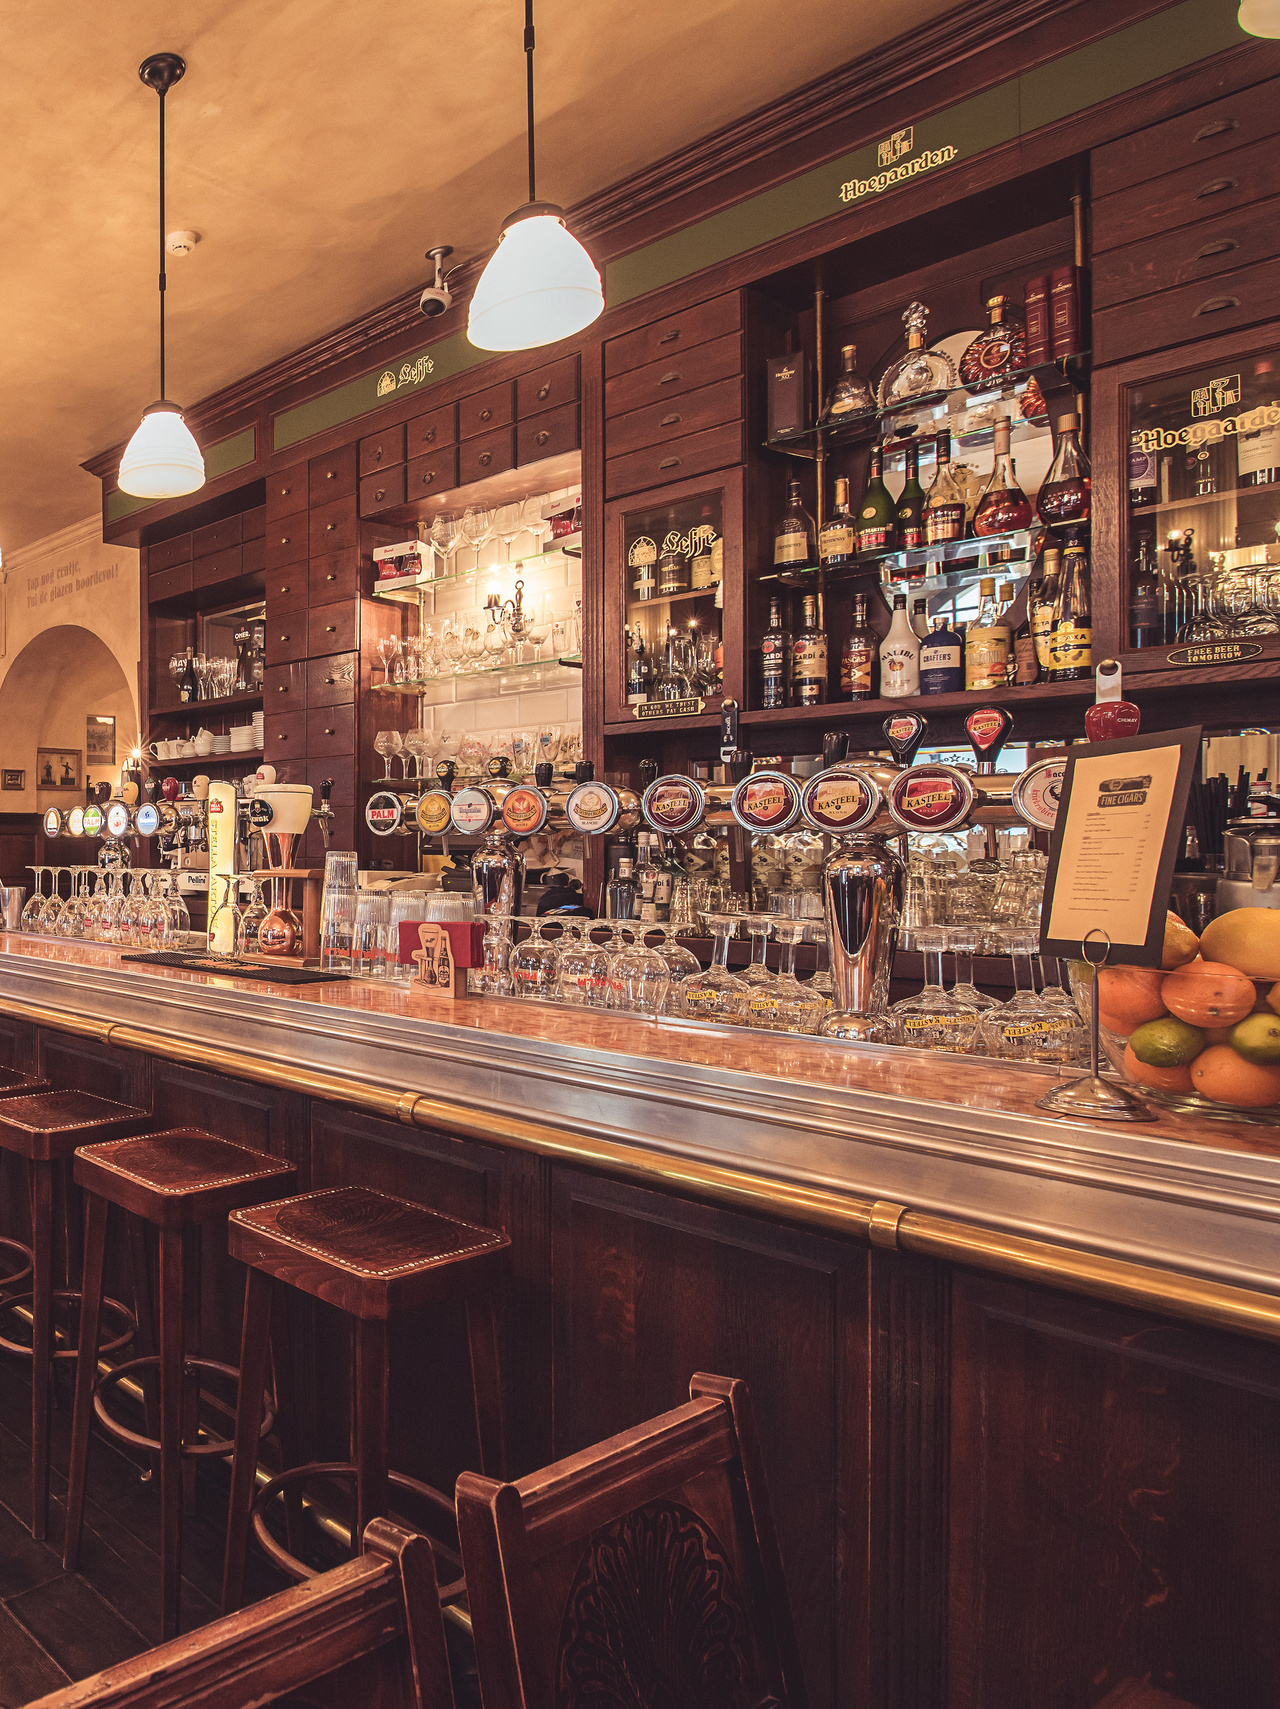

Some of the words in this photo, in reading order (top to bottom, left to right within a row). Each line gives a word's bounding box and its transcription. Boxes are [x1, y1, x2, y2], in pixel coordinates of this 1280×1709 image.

[839, 145, 954, 202] Hoegaarden
[397, 356, 434, 388] Leffe
[1136, 405, 1280, 453] Hoegaarde
[659, 525, 718, 560] Leffe
[27, 577, 39, 591] Tap
[41, 568, 54, 585] nog
[50, 582, 73, 602] glazen
[1033, 620, 1050, 628] META
[1051, 633, 1087, 643] METAXA
[764, 652, 784, 661] CARDÍ
[795, 652, 816, 661] CARDÍ
[881, 649, 916, 661] MALIBU
[1187, 648, 1212, 656] FREE
[1215, 645, 1240, 653] BEER
[923, 653, 952, 663] CRAFTER'S
[1186, 651, 1242, 663] TOMORROW
[676, 700, 695, 708] TRUST
[641, 709, 664, 717] OTHERS
[747, 796, 783, 811] KASTEEL
[818, 795, 858, 811] KASTEEL
[907, 793, 951, 808] KASTEEL
[1100, 795, 1117, 805] FINE
[1118, 792, 1144, 804] CIGARS
[655, 800, 688, 812] KASTEEL
[371, 810, 394, 819] PALM
[84, 818, 100, 826] PALM
[188, 875, 207, 884] Pellini
[907, 1016, 941, 1027] KASTEEL
[1006, 1021, 1043, 1035] KASTEEL
